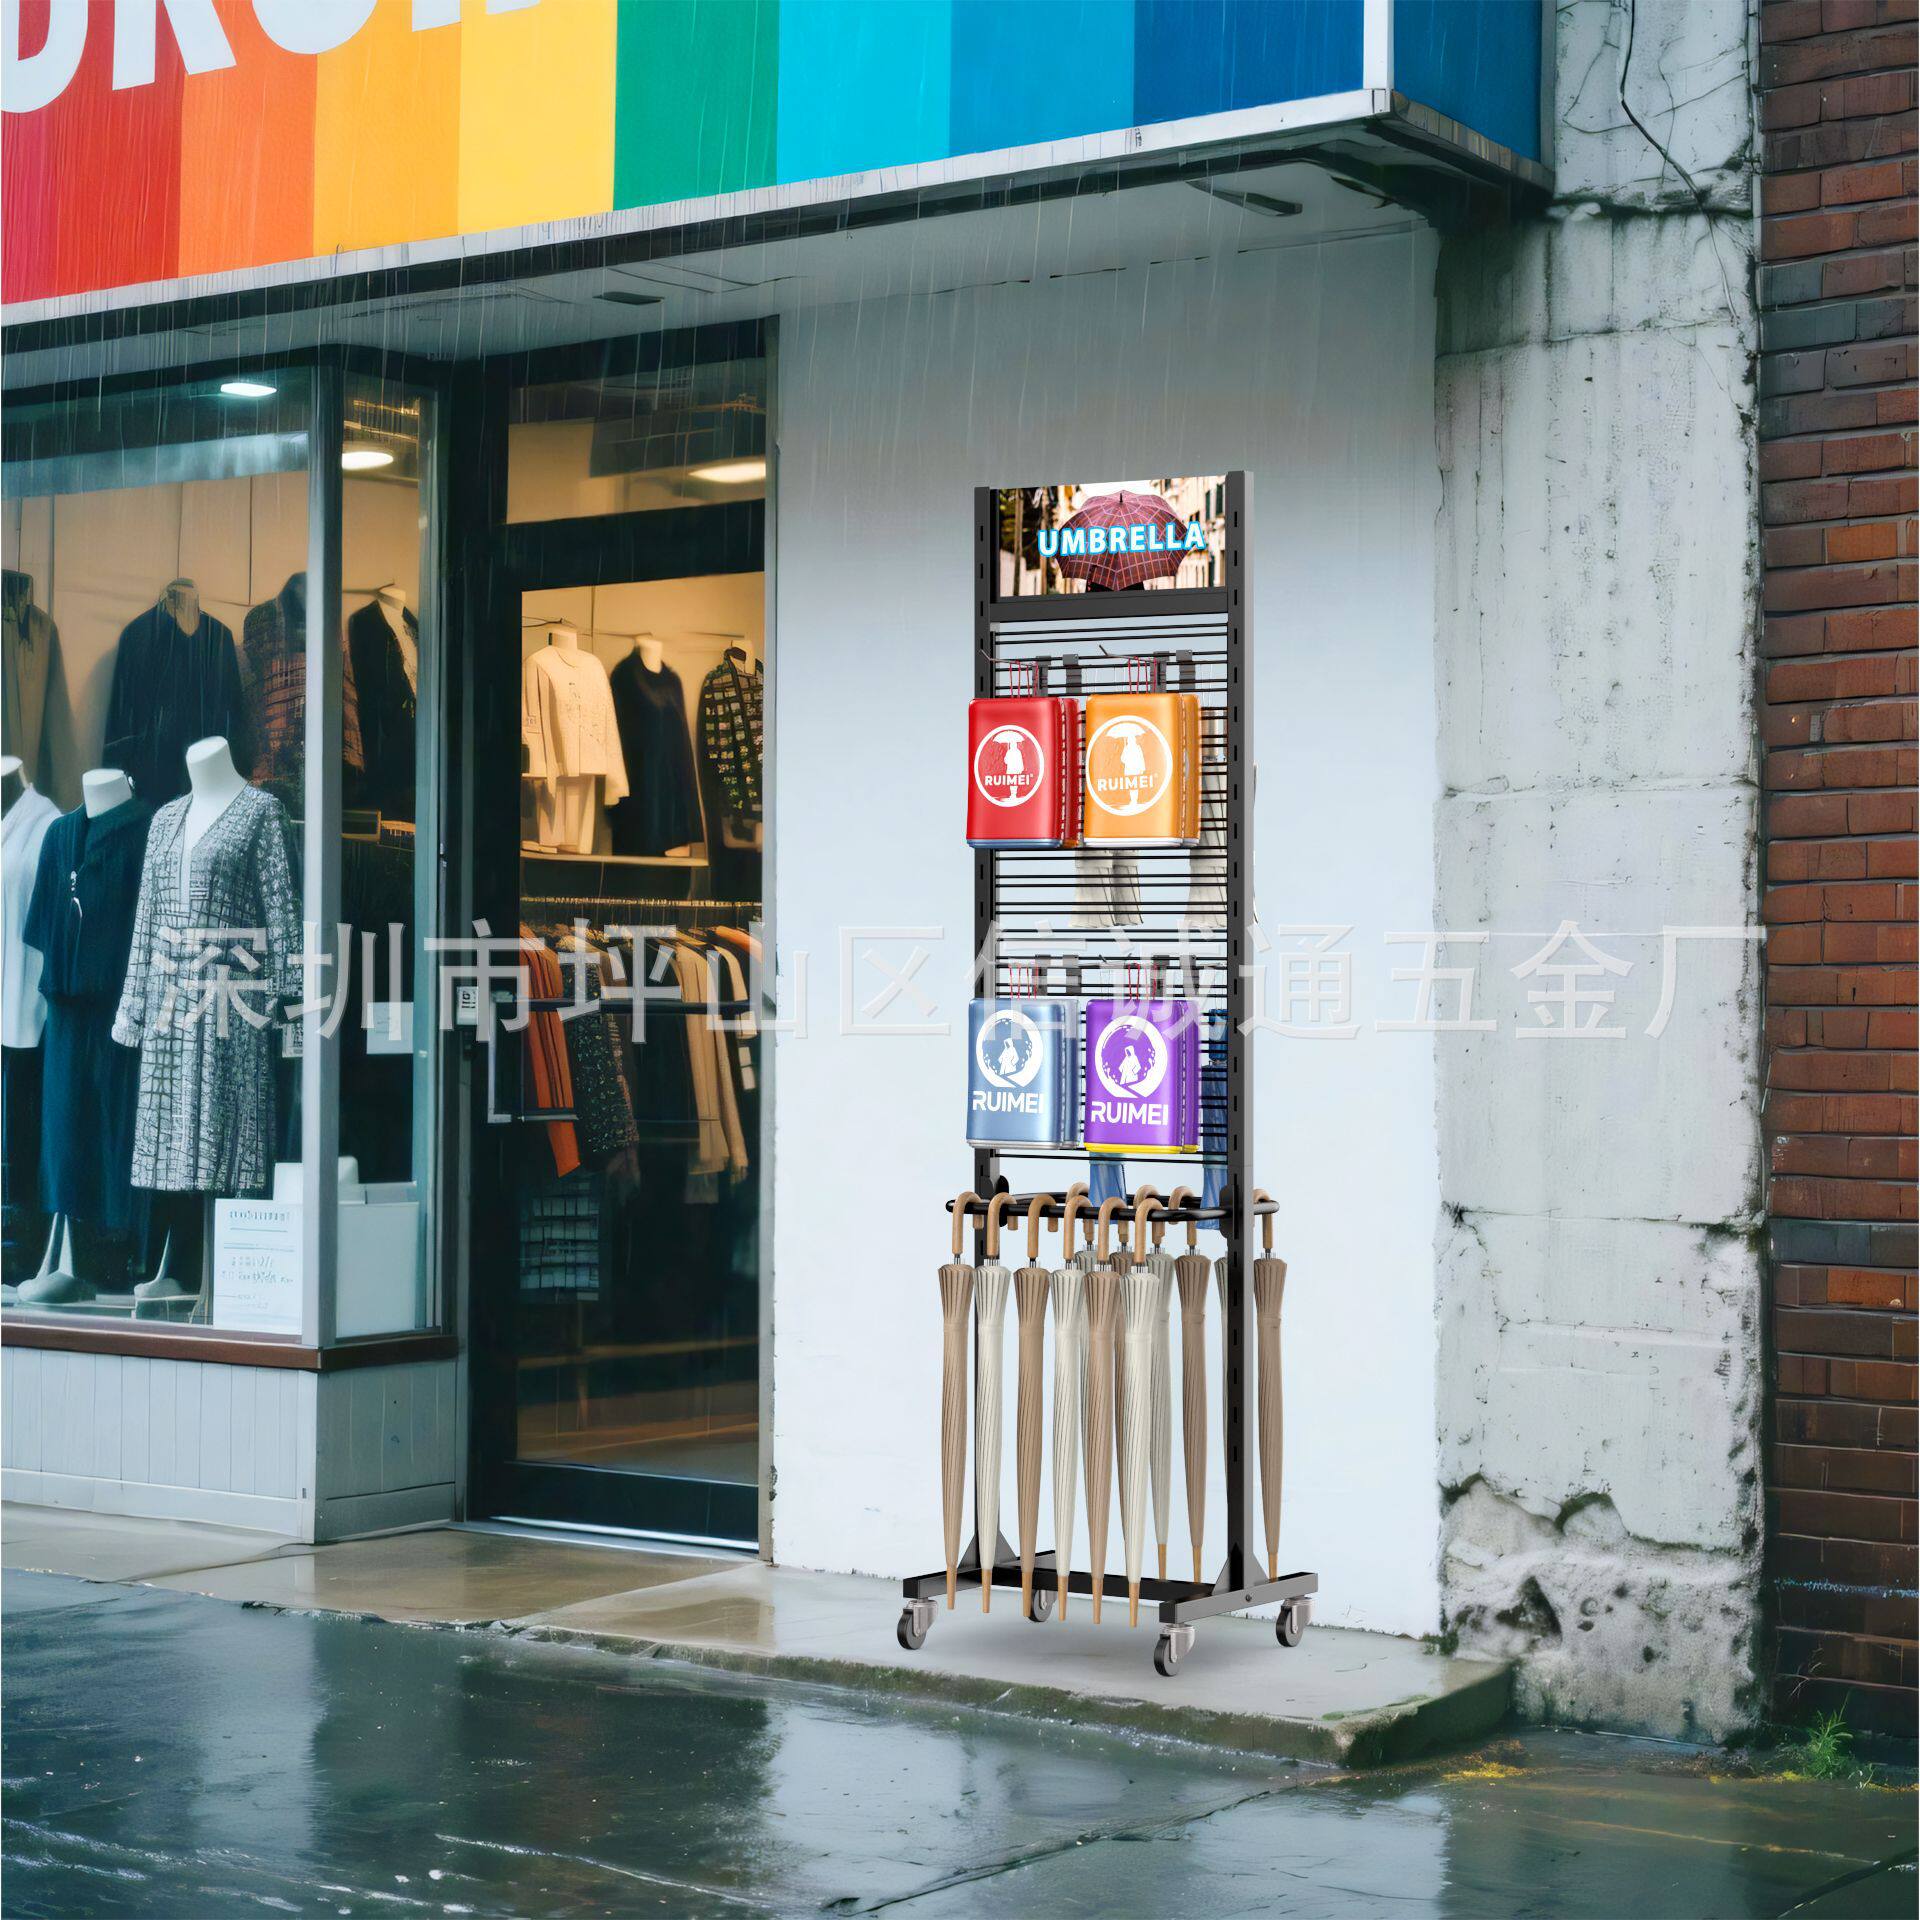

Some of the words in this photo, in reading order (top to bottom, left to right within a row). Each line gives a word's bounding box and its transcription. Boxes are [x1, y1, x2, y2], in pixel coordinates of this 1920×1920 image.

[1038, 521, 1207, 557] UMBRELLA
[984, 774, 1031, 787] RUIMEI
[1097, 775, 1154, 791] RUIMEI
[972, 1090, 1045, 1114] RUIMEI
[1090, 1101, 1169, 1126] RUIMEI
